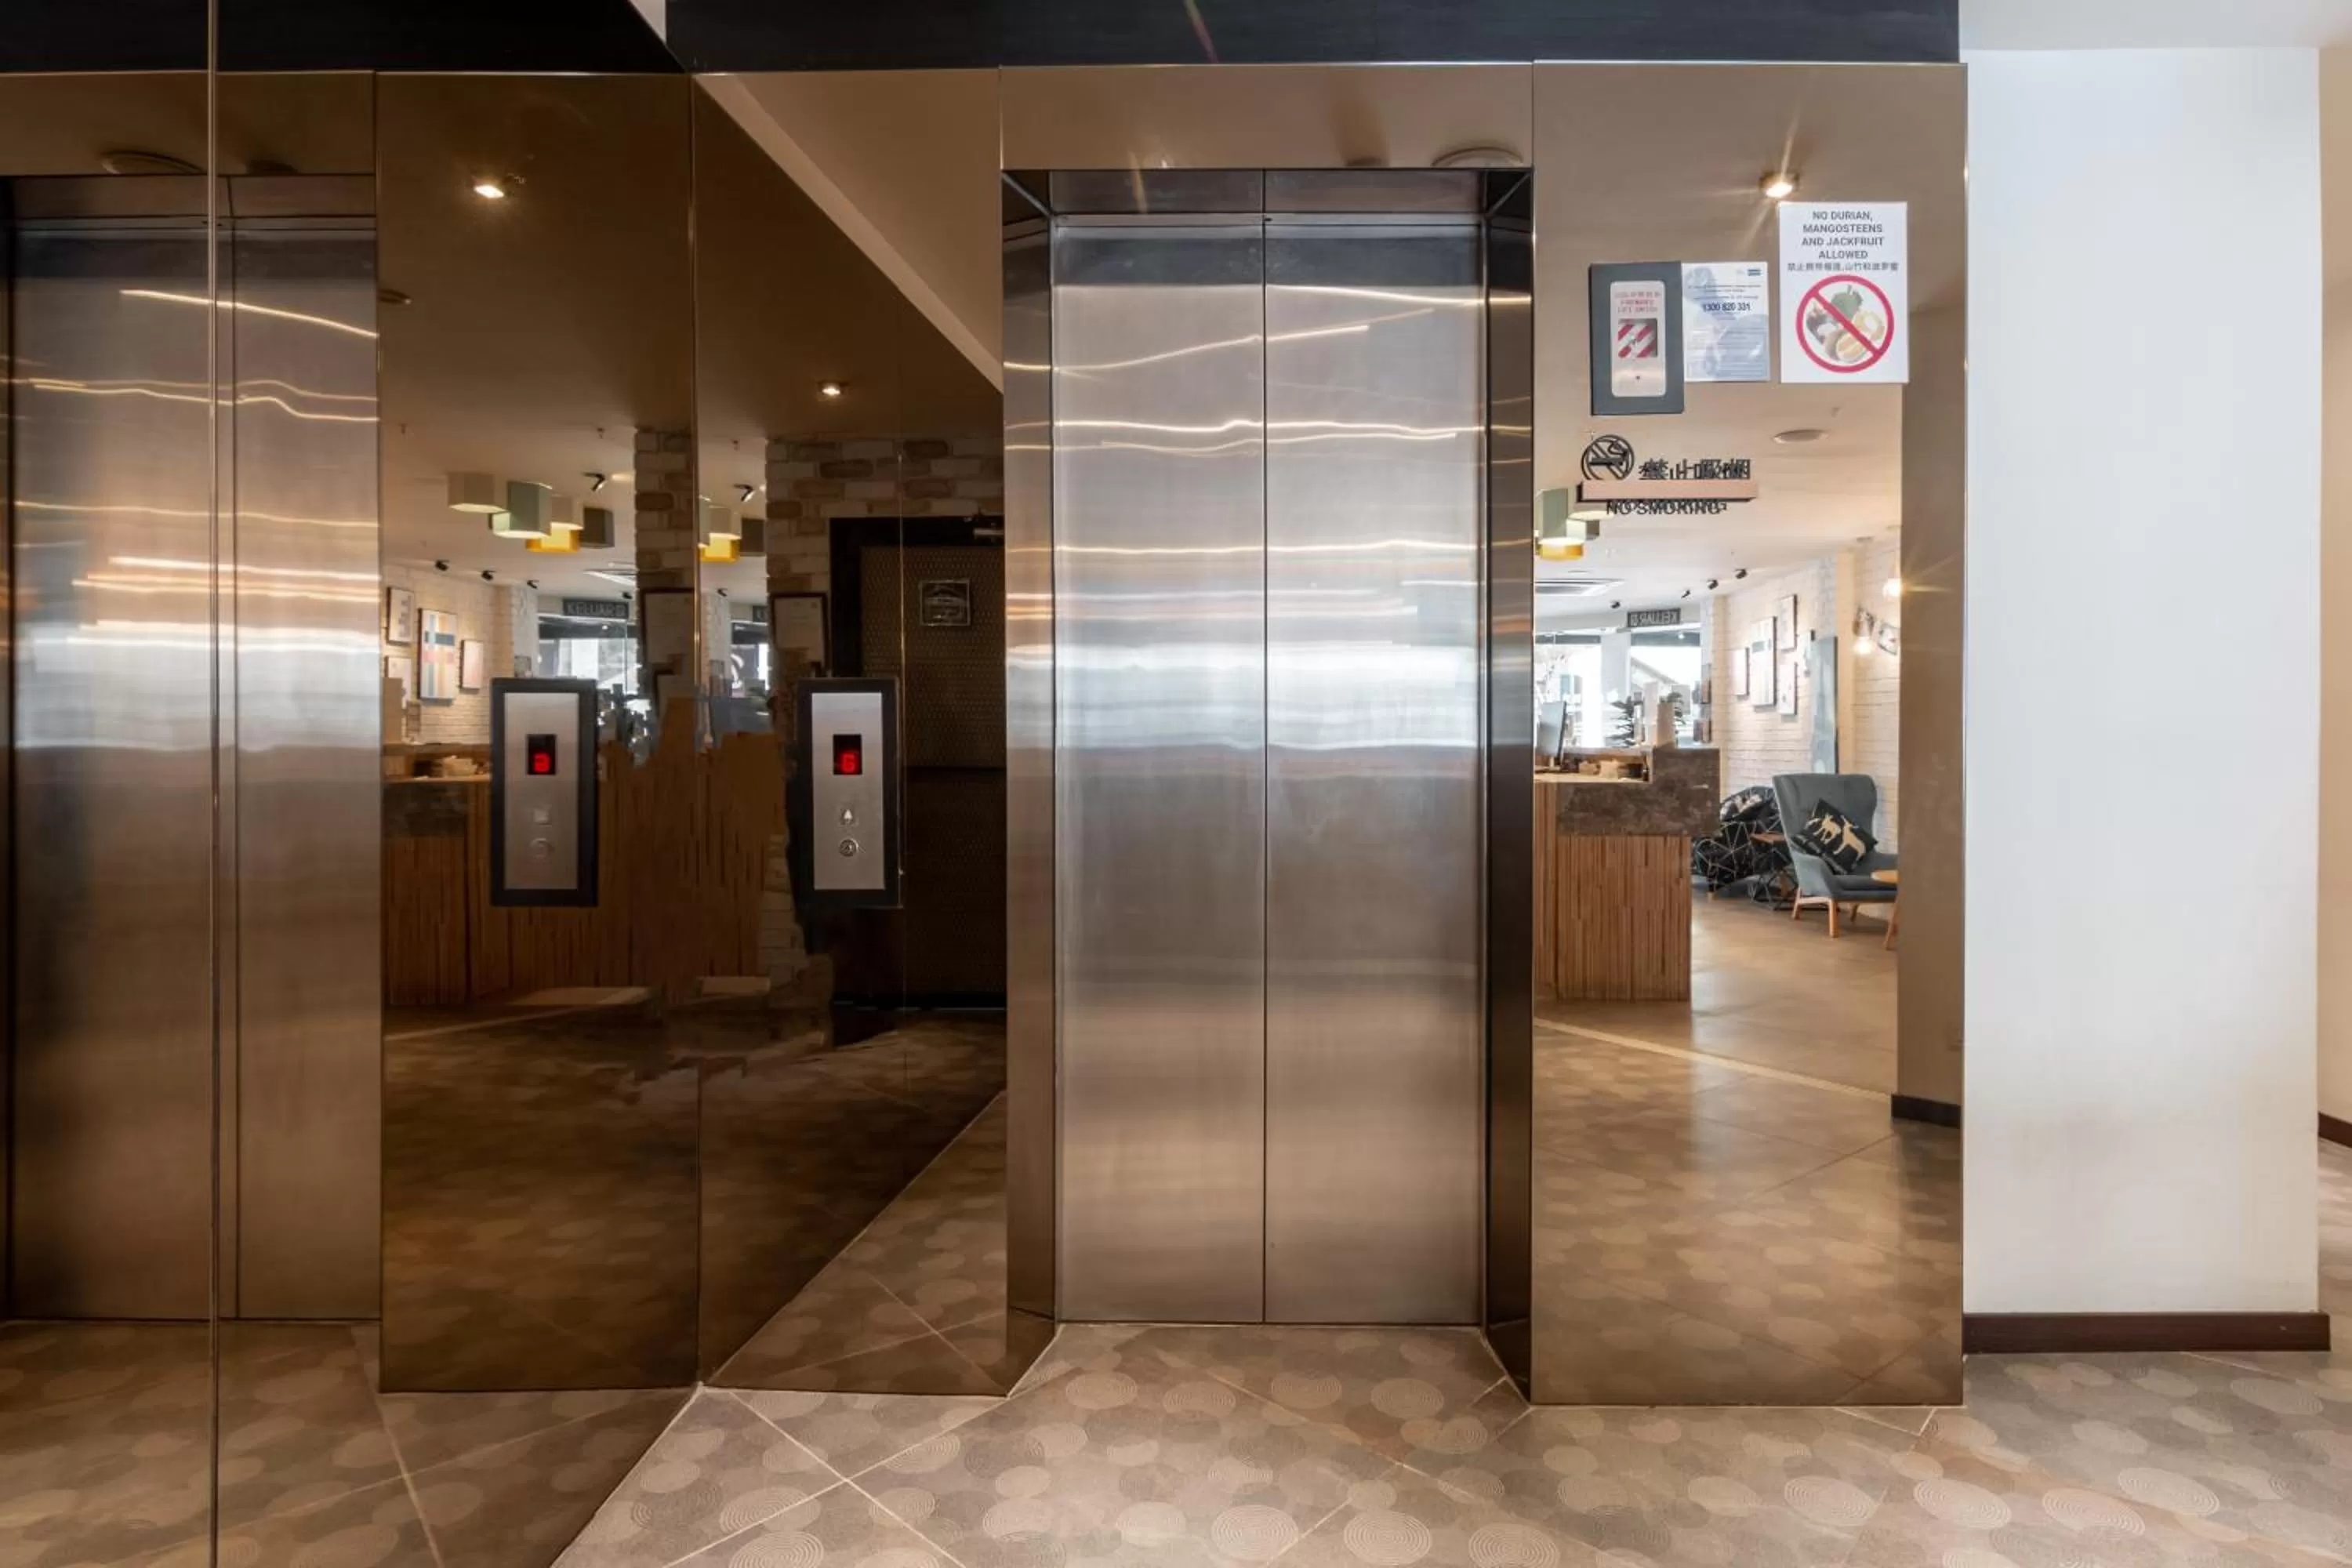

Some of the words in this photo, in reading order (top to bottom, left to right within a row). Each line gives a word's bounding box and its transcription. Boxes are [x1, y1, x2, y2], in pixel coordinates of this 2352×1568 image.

[1812, 211, 1828, 220] NO
[1831, 211, 1873, 221] DURIAN,
[1802, 223, 1883, 233] MANGOSTEENS
[1802, 237, 1824, 245] AND
[1826, 237, 1885, 246] JACKFRUIT
[1818, 250, 1869, 260] ALLOWED
[1606, 499, 1630, 515] NO
